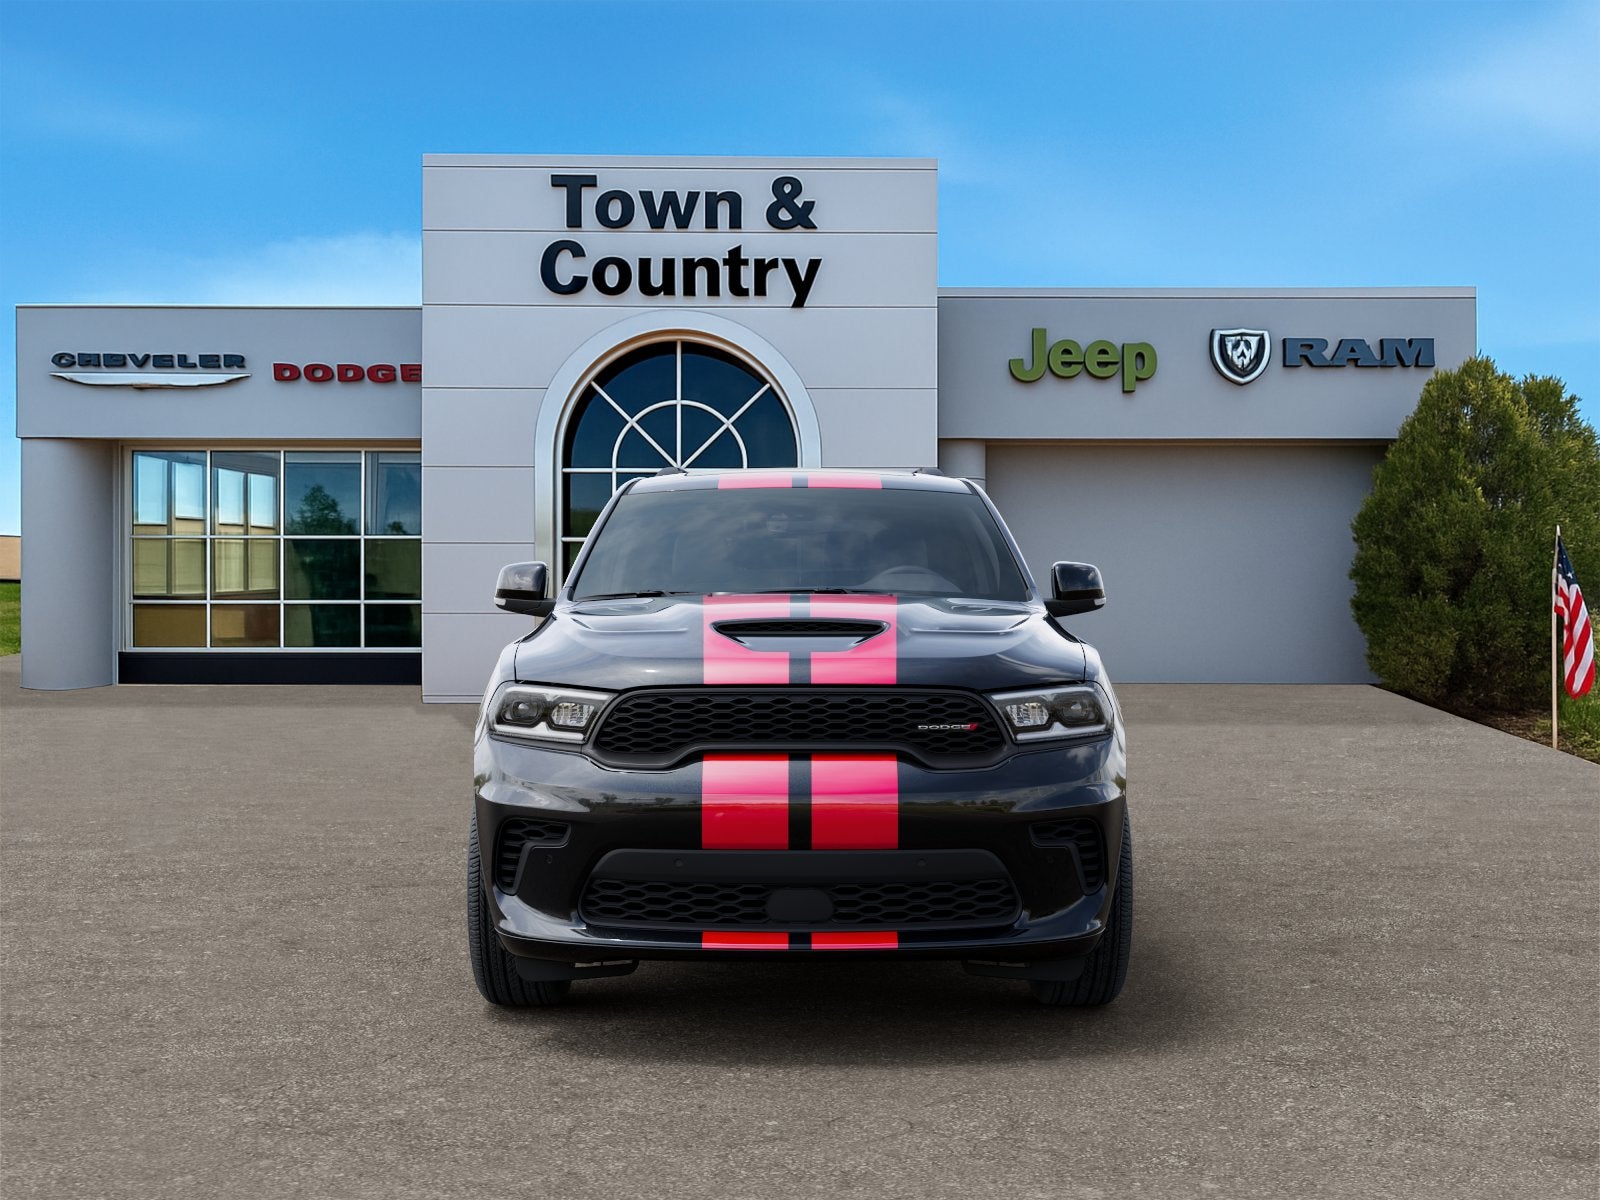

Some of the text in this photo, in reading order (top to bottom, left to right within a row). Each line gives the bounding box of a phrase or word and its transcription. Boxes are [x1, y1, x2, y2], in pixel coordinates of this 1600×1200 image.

[550, 174, 818, 230] Town &
[540, 239, 822, 308] Country
[273, 363, 422, 383] DODGE
[1009, 327, 1158, 393] Jeep
[1282, 337, 1436, 368] RAM
